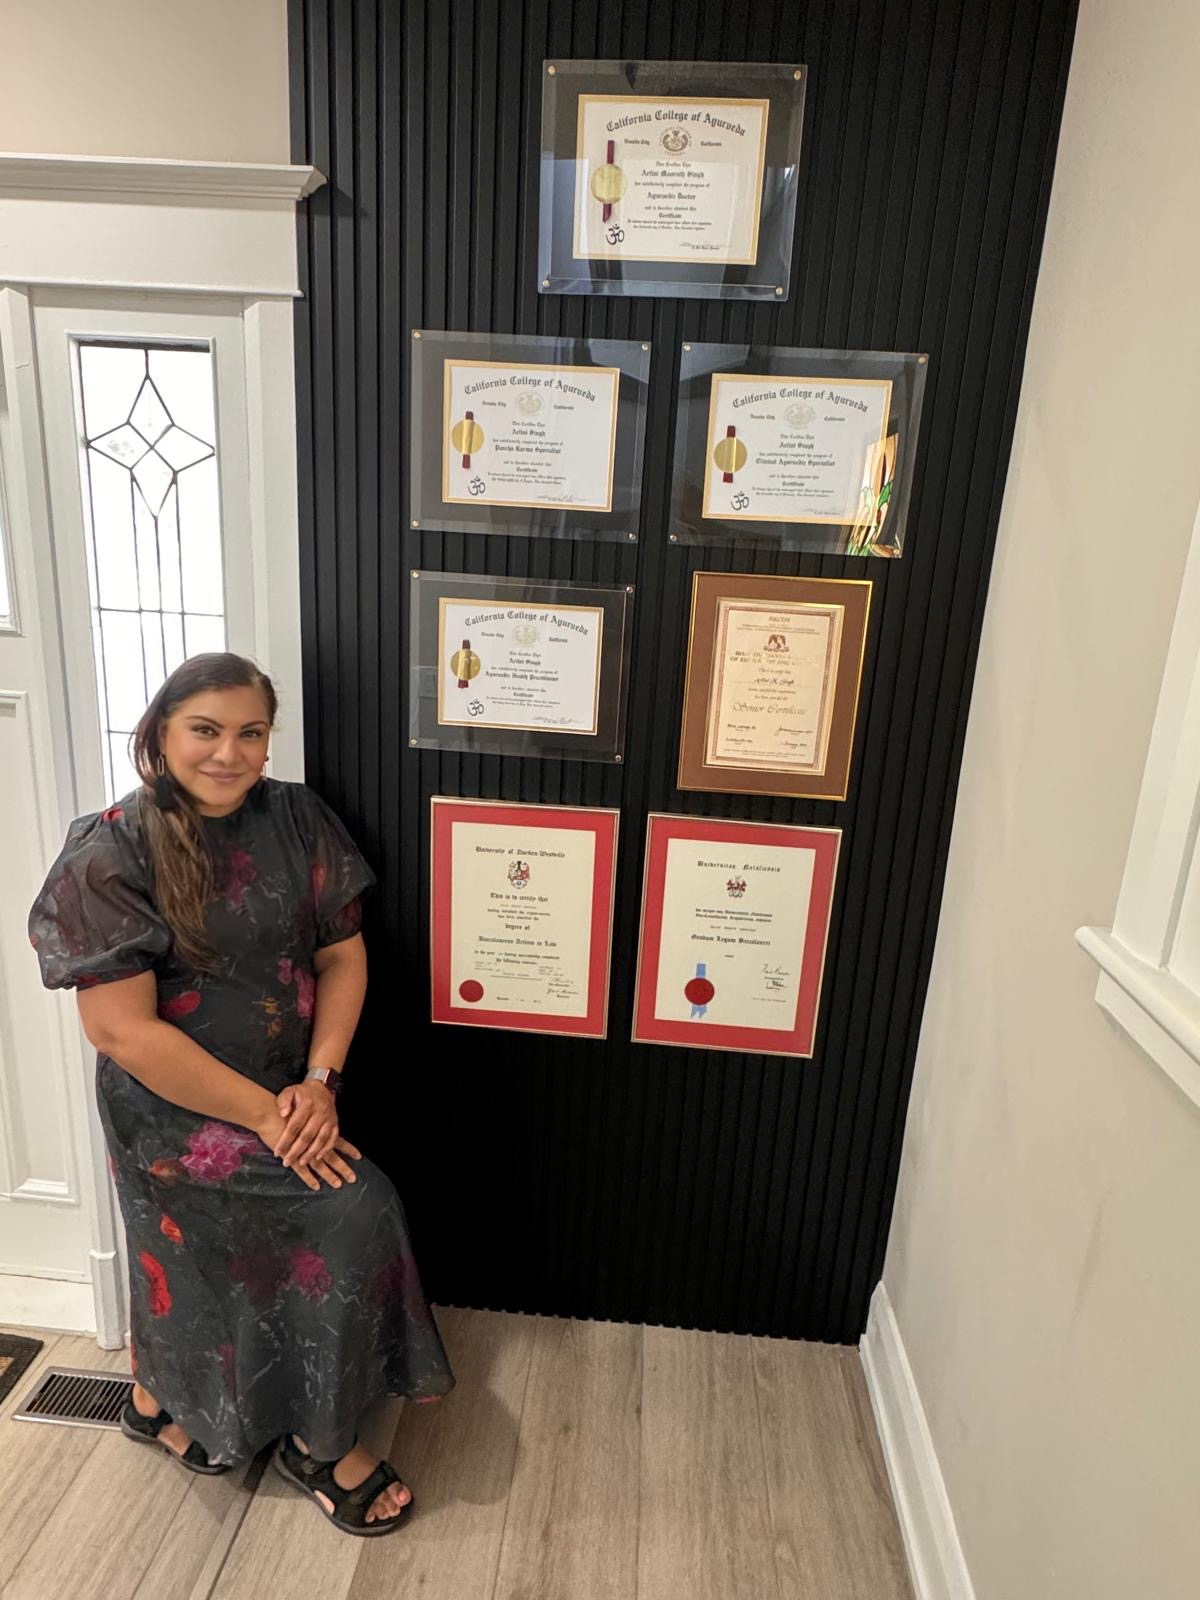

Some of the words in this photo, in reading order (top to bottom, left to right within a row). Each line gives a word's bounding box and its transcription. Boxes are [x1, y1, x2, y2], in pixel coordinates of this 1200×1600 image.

[606, 113, 652, 132] California
[655, 110, 688, 121] College
[703, 113, 746, 136] Ayurveda
[464, 378, 507, 395] California
[510, 375, 542, 388] College
[544, 379, 553, 388] of
[555, 380, 596, 402] Ayurveda
[733, 391, 777, 408] California
[779, 388, 812, 399] College
[815, 391, 825, 399] of
[827, 391, 869, 413] Ayurveda
[465, 612, 505, 626] California
[507, 610, 537, 621] College
[540, 614, 548, 622] of
[551, 616, 589, 635] Ayurveda
